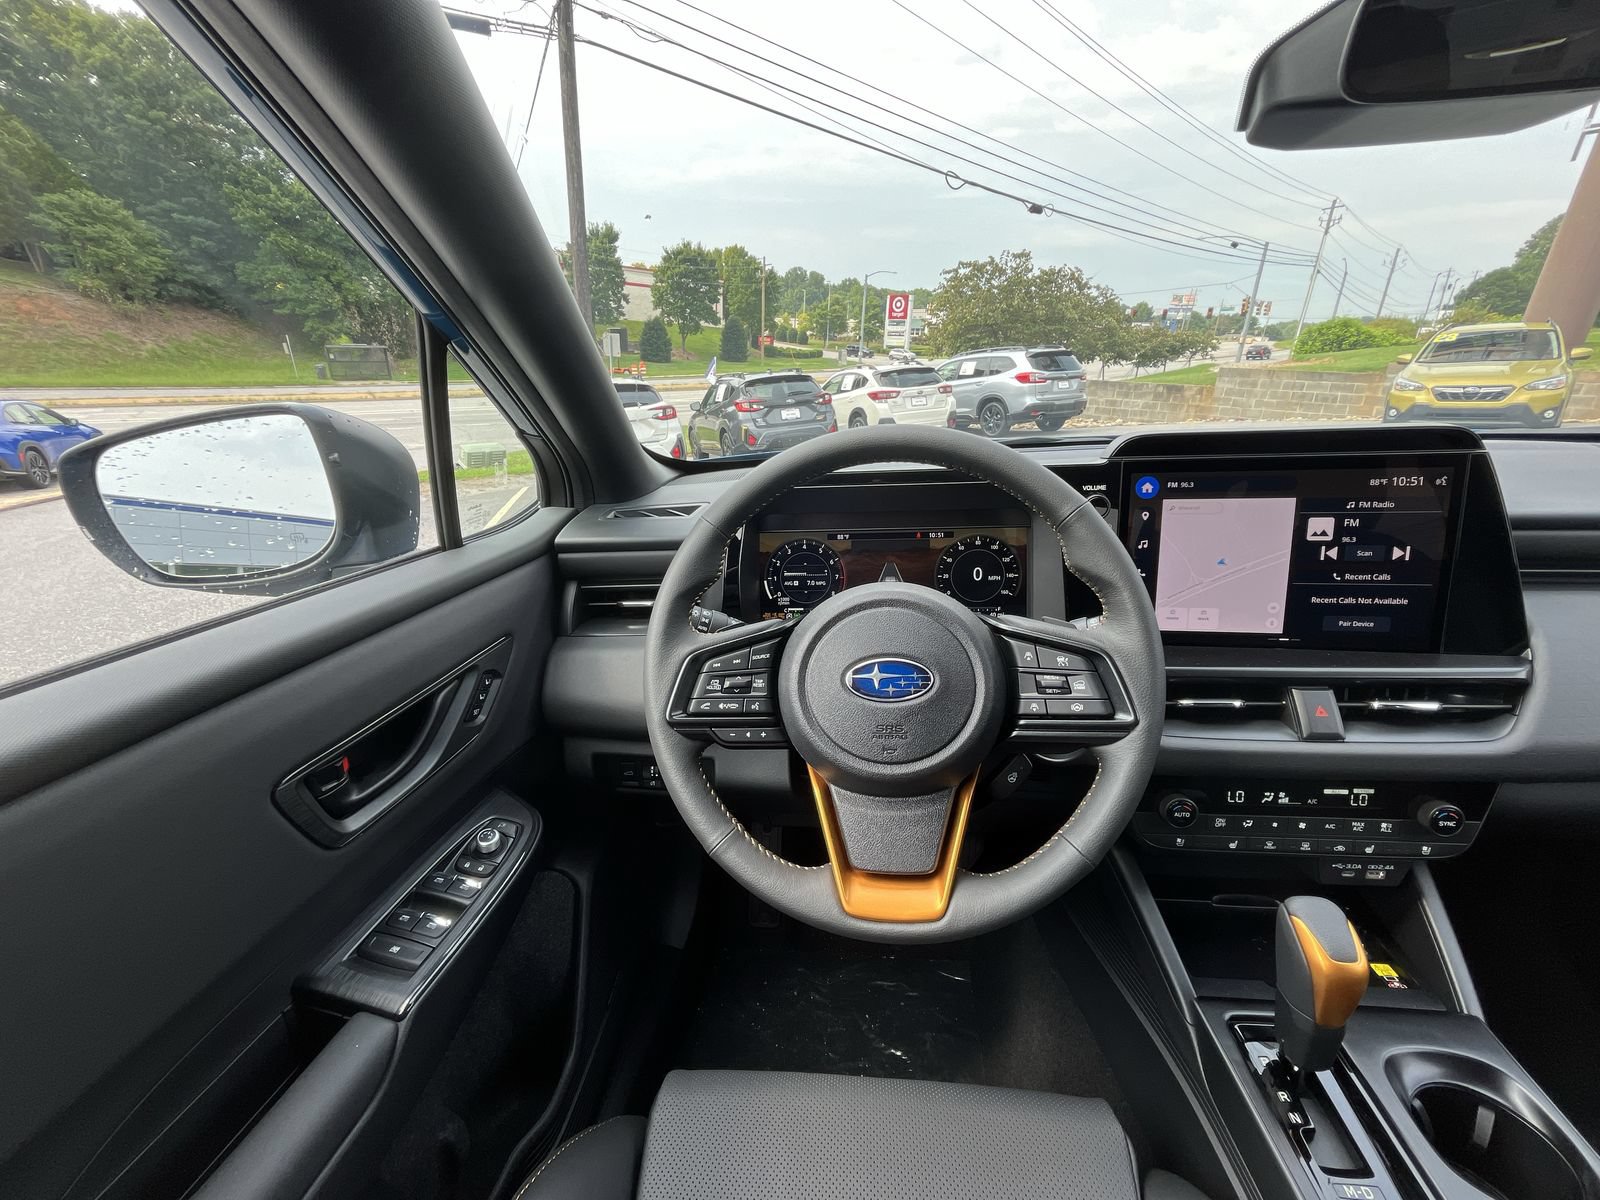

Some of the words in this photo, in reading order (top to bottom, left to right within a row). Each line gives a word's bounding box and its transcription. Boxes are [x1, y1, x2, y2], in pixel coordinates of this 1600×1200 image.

[1167, 481, 1178, 489] FM
[1392, 476, 1424, 487] 10:51
[1358, 501, 1371, 509] FM
[1343, 518, 1360, 527] FM
[972, 567, 983, 581] 0
[1344, 573, 1371, 581] Recent
[1372, 573, 1392, 581] Calls
[1311, 596, 1337, 604] Recent
[1338, 596, 1357, 604] Calls
[1357, 597, 1373, 605] Not
[1373, 597, 1409, 605] Available
[1352, 620, 1375, 628] Device
[1227, 790, 1245, 803] LO
[1350, 793, 1368, 806] LO
[1276, 1090, 1291, 1102] R
[1287, 1111, 1302, 1124] N
